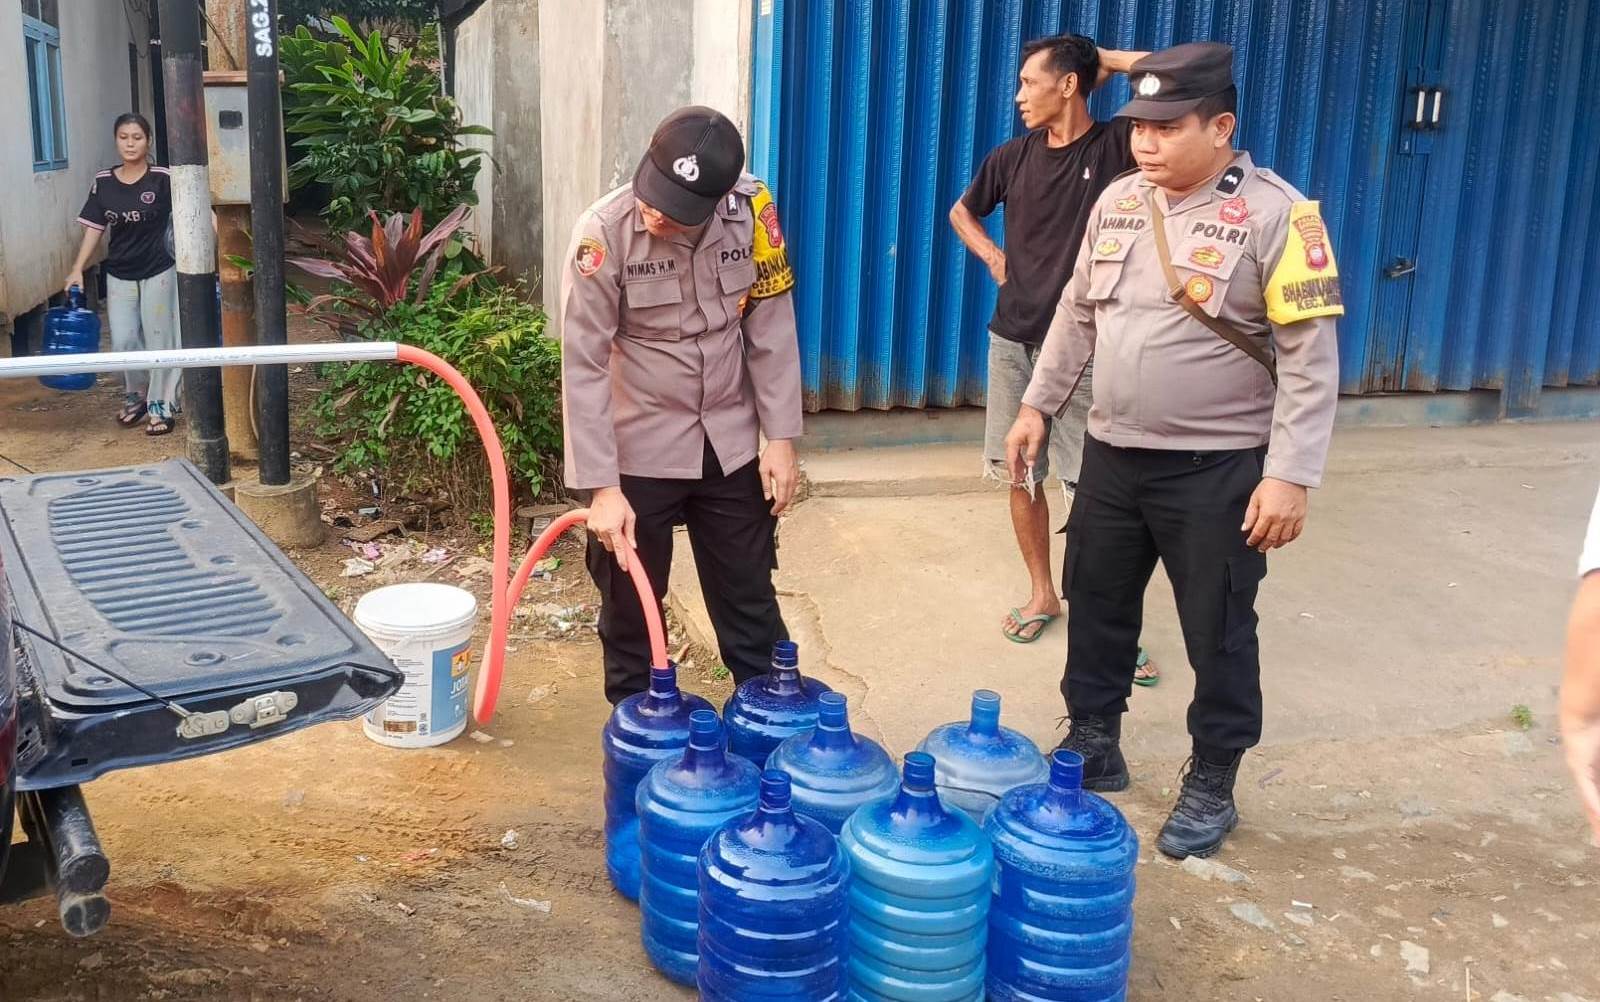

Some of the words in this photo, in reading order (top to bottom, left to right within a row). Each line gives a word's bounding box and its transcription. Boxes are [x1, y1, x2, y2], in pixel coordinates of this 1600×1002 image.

[1101, 216, 1145, 231] AHMAD
[1191, 222, 1248, 246] POLRI
[721, 245, 753, 264] POL
[627, 263, 656, 278] NIMAS
